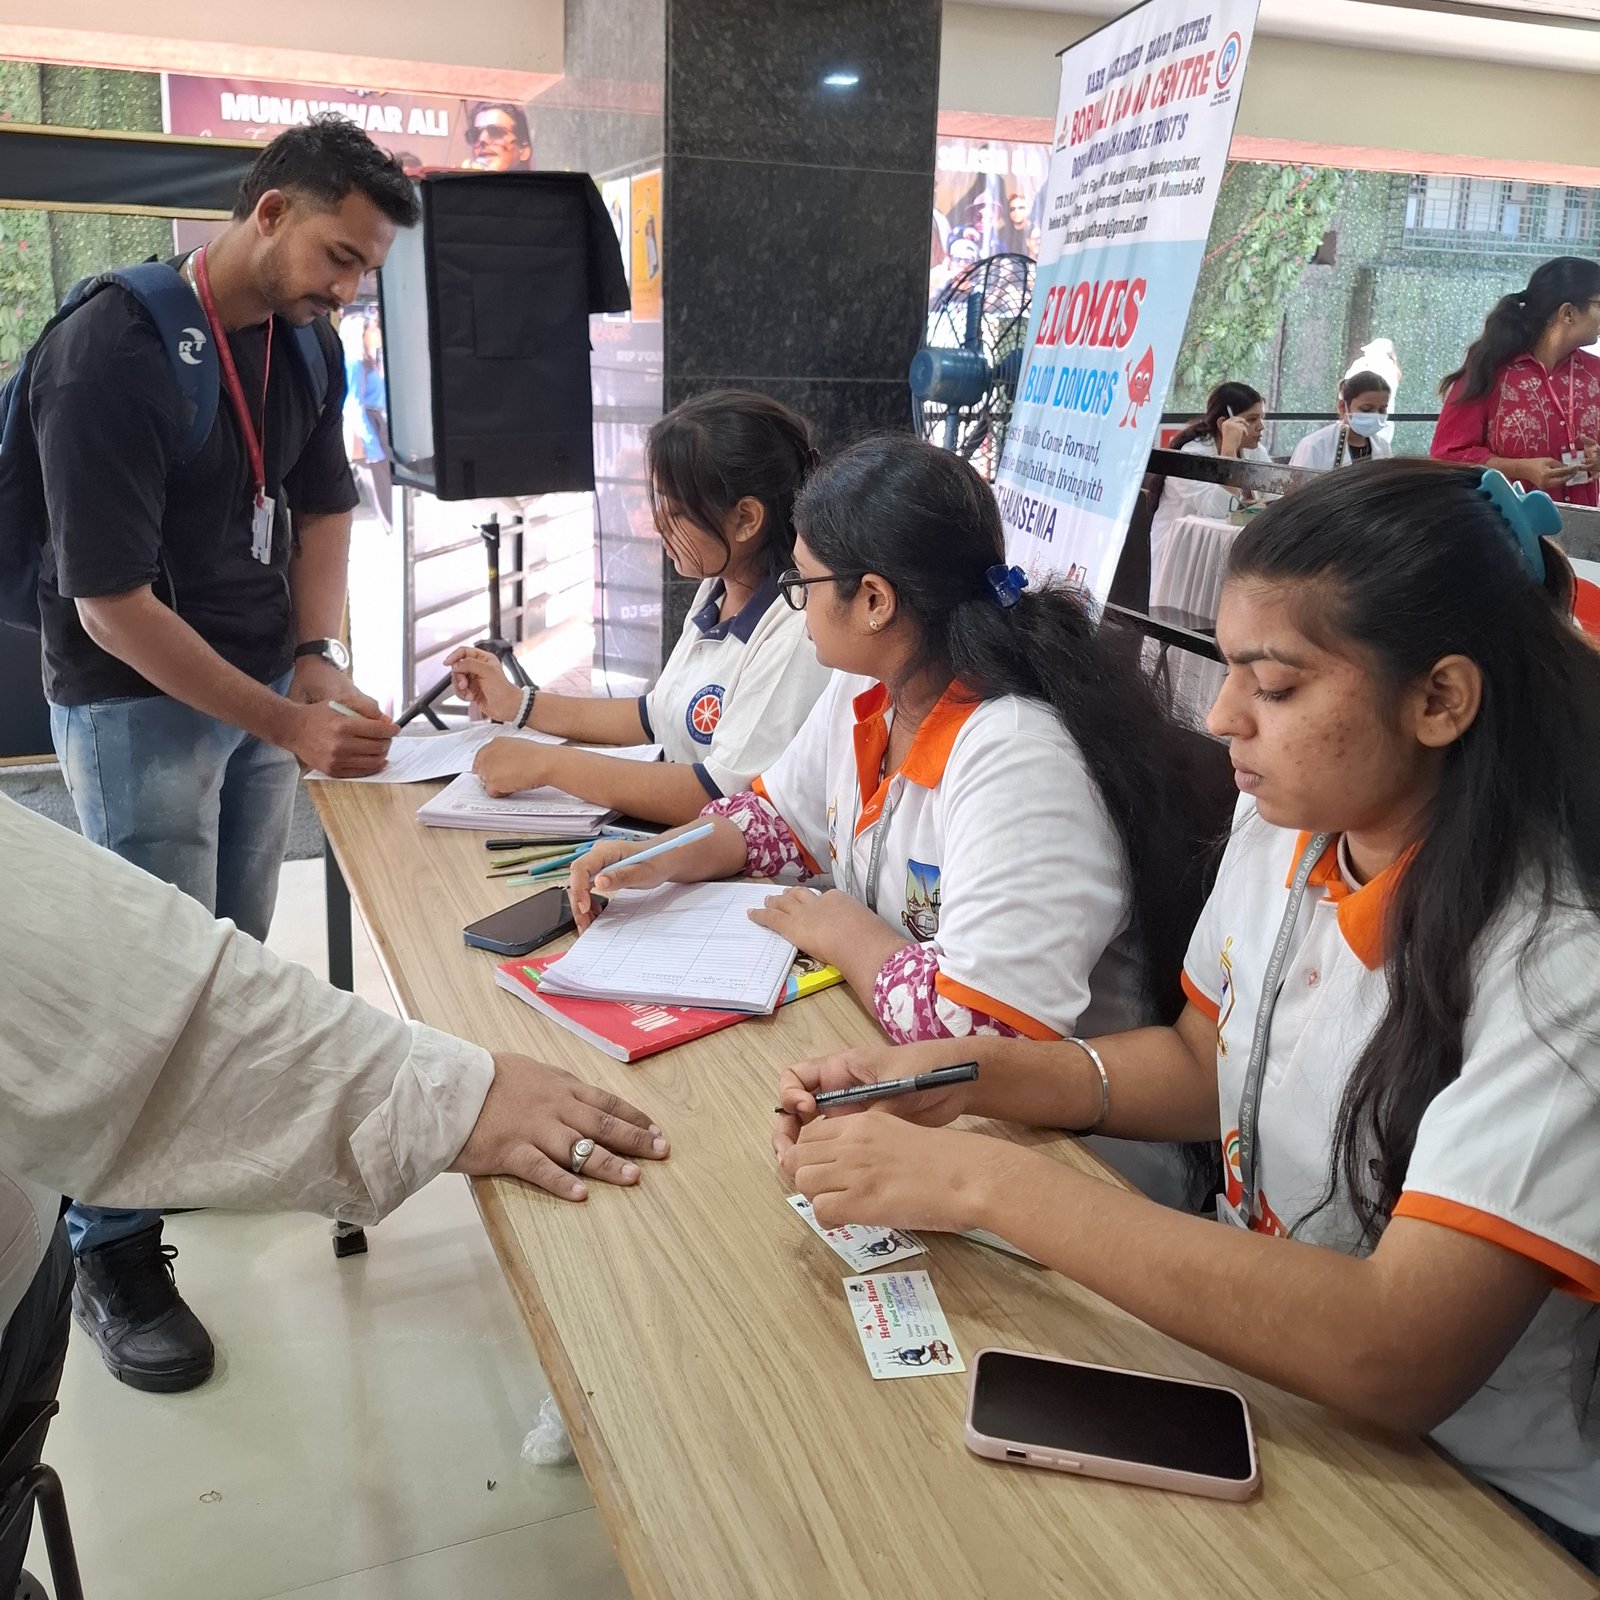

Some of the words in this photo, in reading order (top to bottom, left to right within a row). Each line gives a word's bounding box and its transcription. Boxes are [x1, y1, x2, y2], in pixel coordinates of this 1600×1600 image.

[1150, 50, 1215, 110] CENTRE
[407, 108, 449, 137] ALI
[1150, 113, 1189, 148] TRUST'S
[1158, 176, 1205, 198] Mumbai-68
[1053, 366, 1119, 416] DONOR'S
[1041, 430, 1063, 452] Come
[1062, 435, 1101, 467] Forward,
[1056, 468, 1082, 501] living
[1081, 479, 1103, 502] with
[621, 605, 637, 619] DJ
[1302, 849, 1317, 871] AND
[1294, 870, 1306, 896] ARTS
[1290, 896, 1299, 911] OF
[1275, 912, 1294, 958] COLLEGE
[1260, 959, 1280, 1027] RAMNARAYAN
[631, 1011, 679, 1032] NO
[1251, 1027, 1264, 1066] THAKUR
[1242, 1102, 1251, 1137] 2025-26
[863, 1280, 879, 1302] Hand
[881, 1282, 894, 1309] Coupon
[873, 1303, 891, 1339] Helping
[889, 1309, 901, 1328] Food
